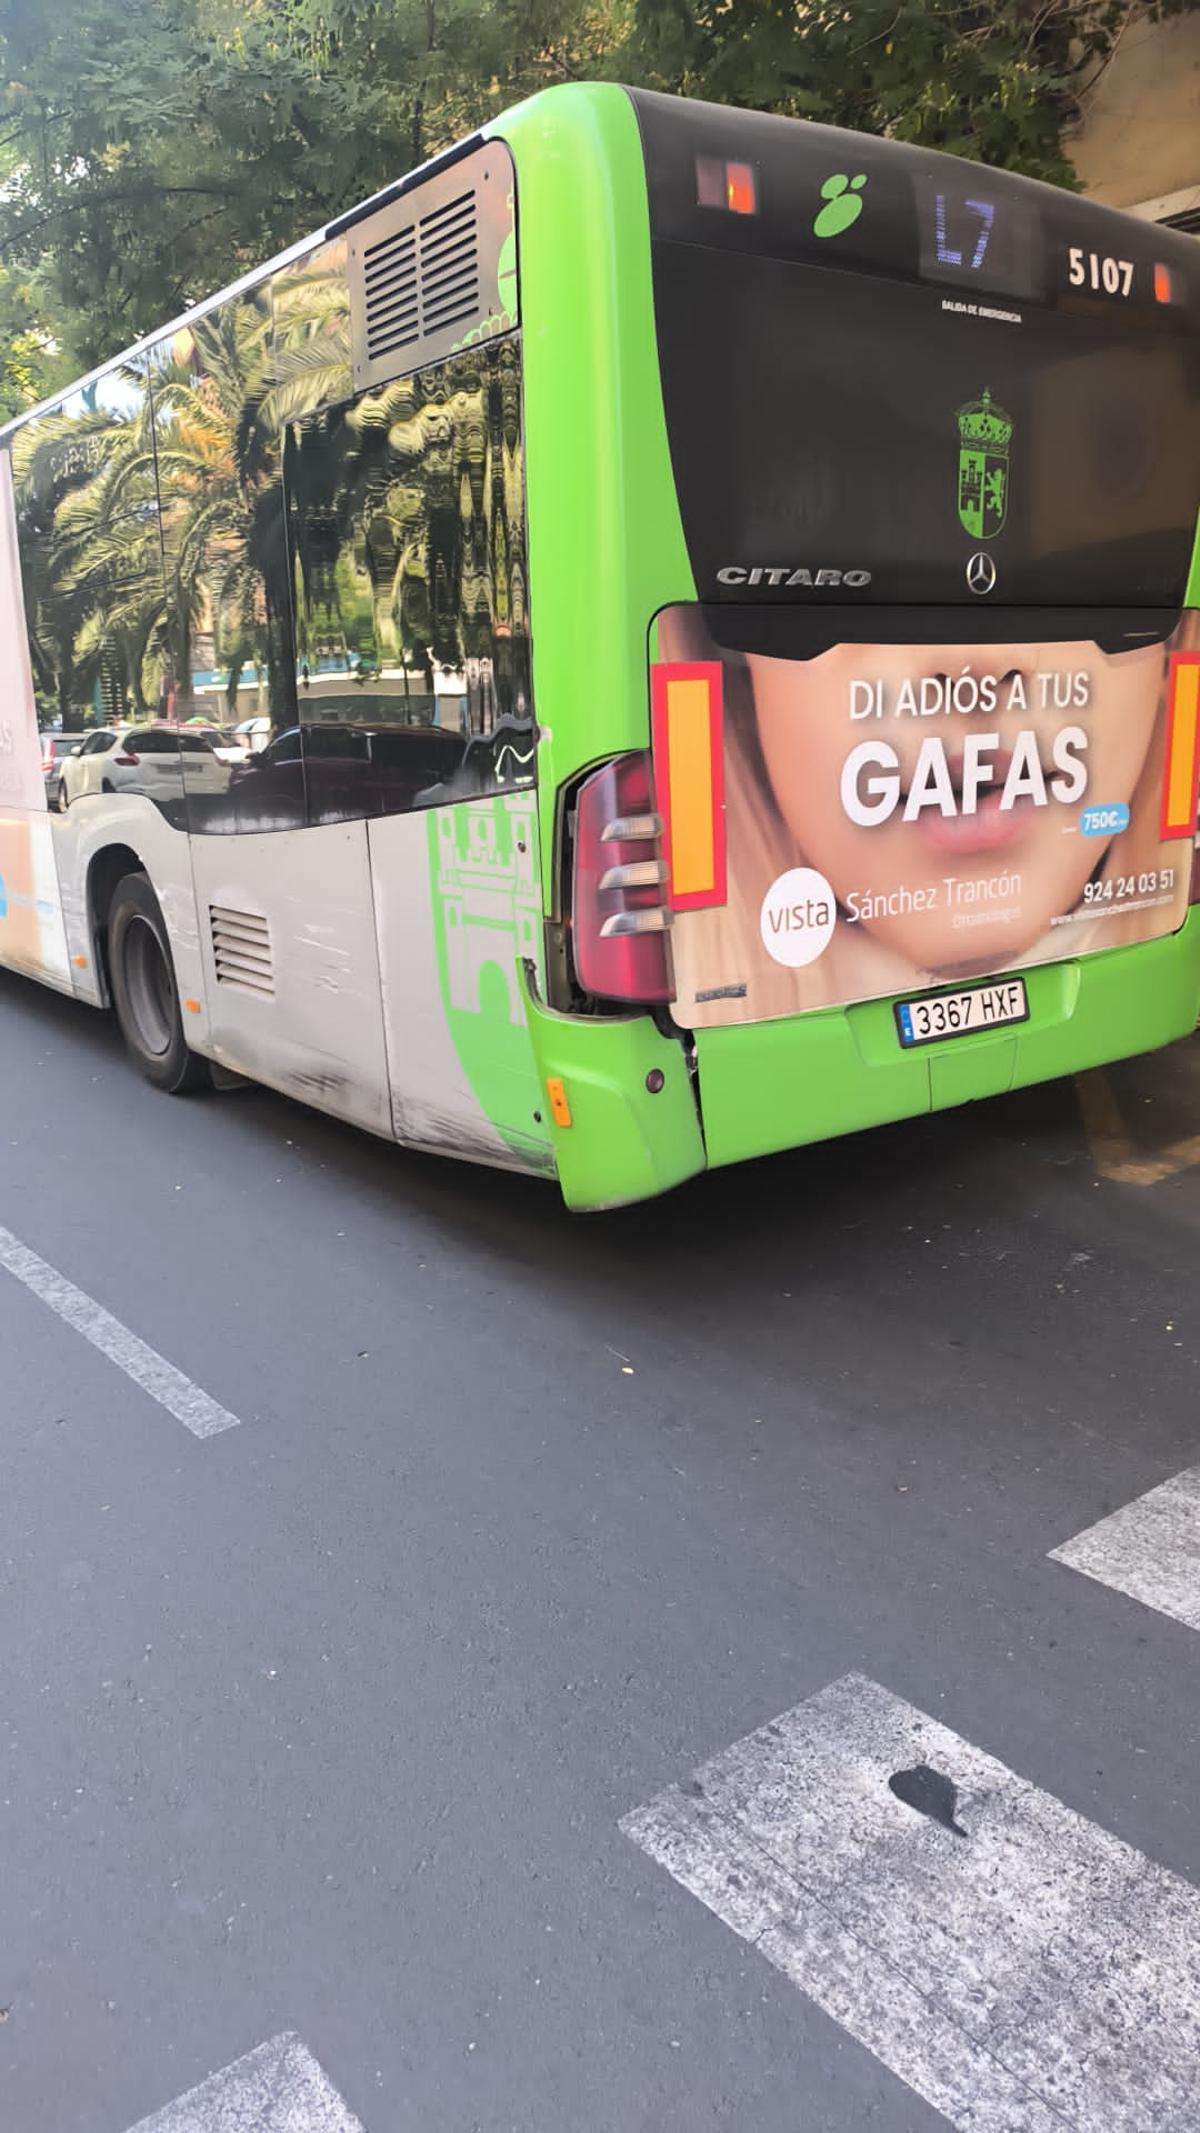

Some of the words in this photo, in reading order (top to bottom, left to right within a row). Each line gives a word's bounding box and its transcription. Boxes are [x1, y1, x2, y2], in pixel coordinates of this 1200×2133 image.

[936, 195, 994, 268] L7
[1068, 247, 1135, 297] 5107
[716, 566, 872, 587] CITARO
[849, 680, 883, 720] DI
[895, 666, 997, 717] ADIÓS
[1006, 674, 1027, 710] A
[1038, 672, 1090, 710] TUS
[840, 726, 1089, 827] GAFAS
[846, 886, 937, 922] Sánchez
[942, 869, 1022, 908] Trancón
[1083, 880, 1113, 904] 924
[1116, 876, 1135, 898] 24
[1138, 871, 1157, 893] 03
[1159, 869, 1175, 890] 51
[916, 996, 972, 1035] 3367
[981, 986, 1018, 1021] HXF
